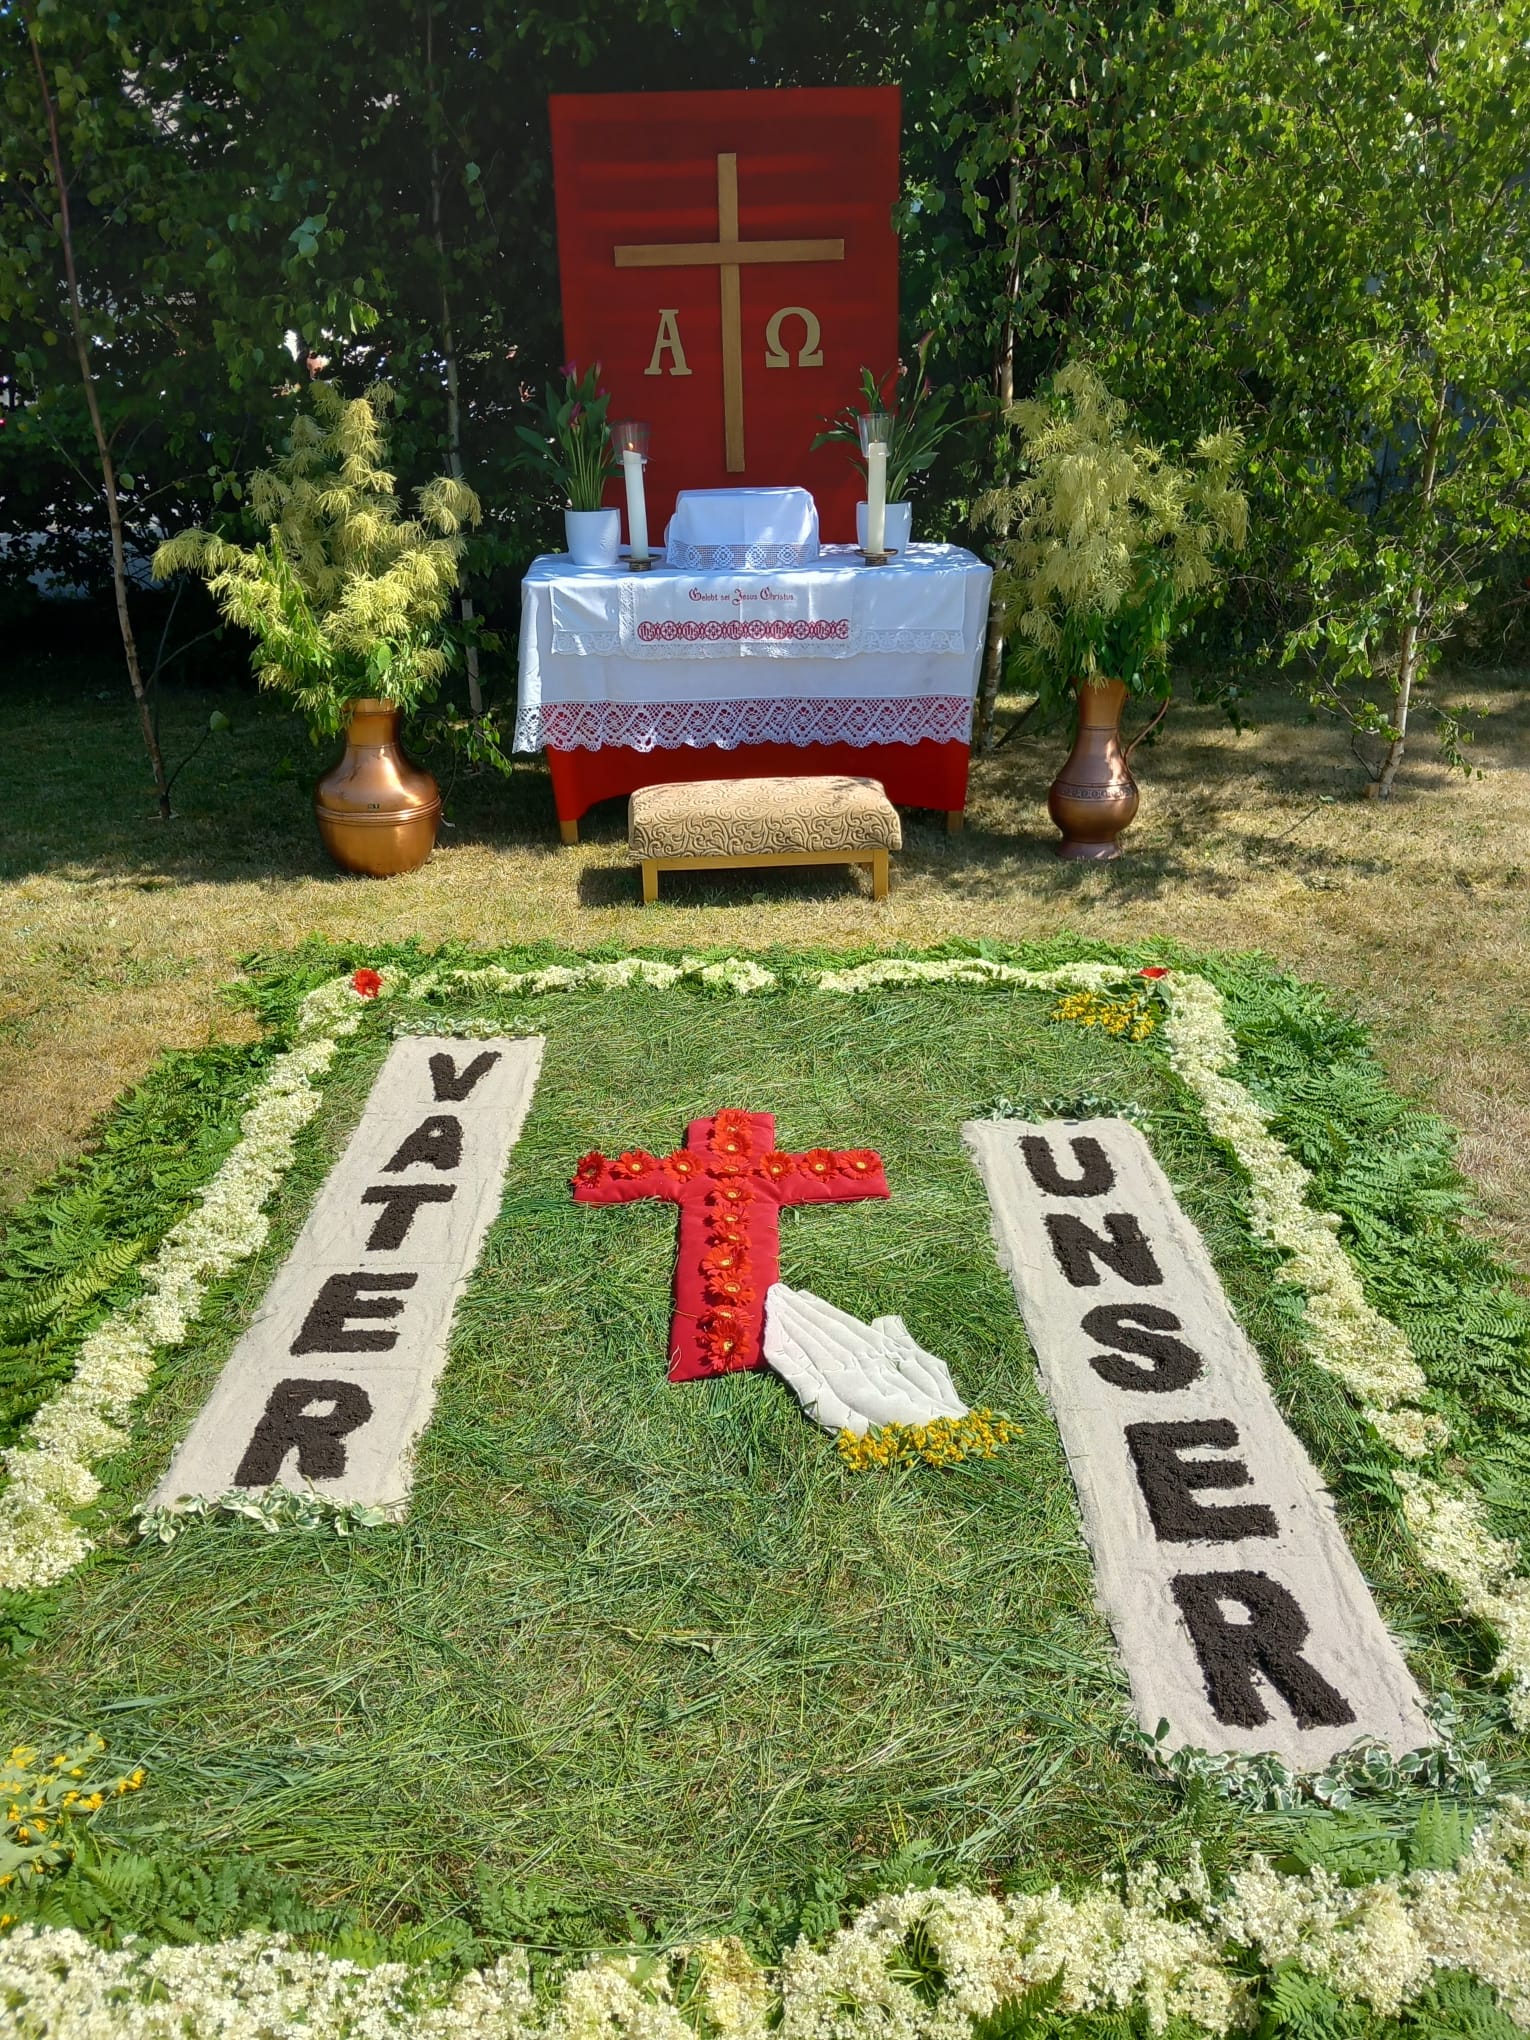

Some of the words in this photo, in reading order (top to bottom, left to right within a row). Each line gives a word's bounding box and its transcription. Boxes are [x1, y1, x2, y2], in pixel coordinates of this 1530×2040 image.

[765, 307, 824, 368] Ω
[731, 588, 758, 606] Jesus
[234, 1051, 502, 1487] VATER
[1020, 1135, 1356, 1730] UNSER
